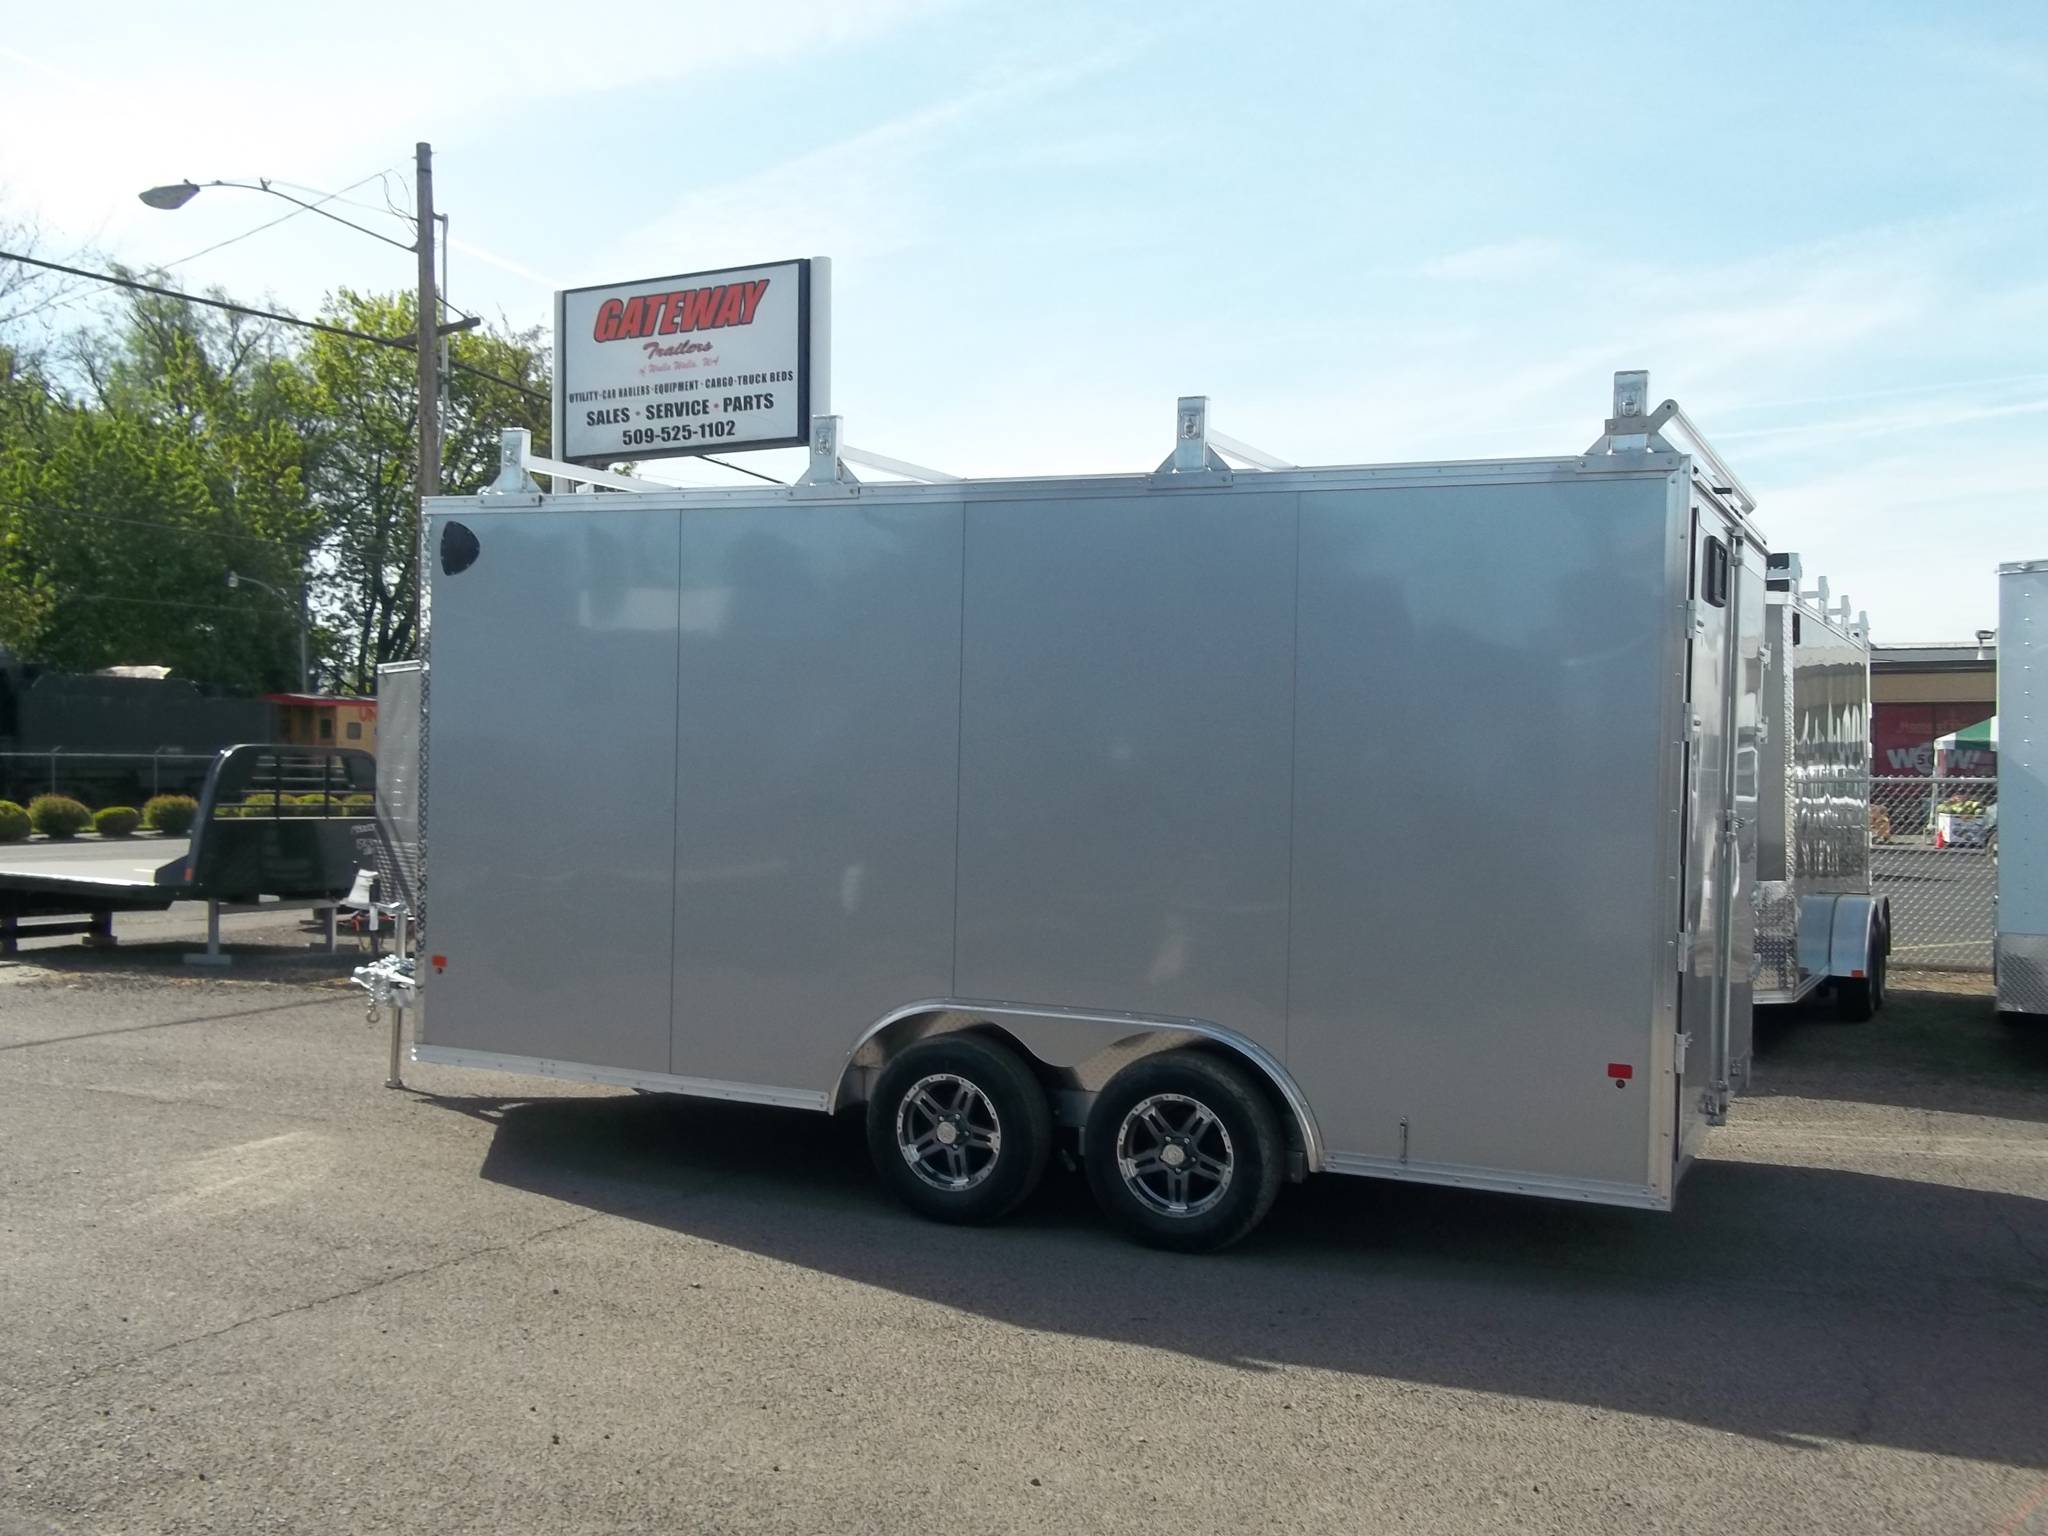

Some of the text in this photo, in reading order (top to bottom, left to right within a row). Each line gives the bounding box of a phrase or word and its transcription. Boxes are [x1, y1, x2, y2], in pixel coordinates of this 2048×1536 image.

[594, 279, 770, 343] GATEWAY
[643, 339, 713, 360] Trailers
[737, 373, 767, 386] TRUCK
[769, 370, 794, 383] BEDS
[586, 393, 774, 426] SALES SERVICE PARTS
[622, 420, 736, 446] 509-525-1102
